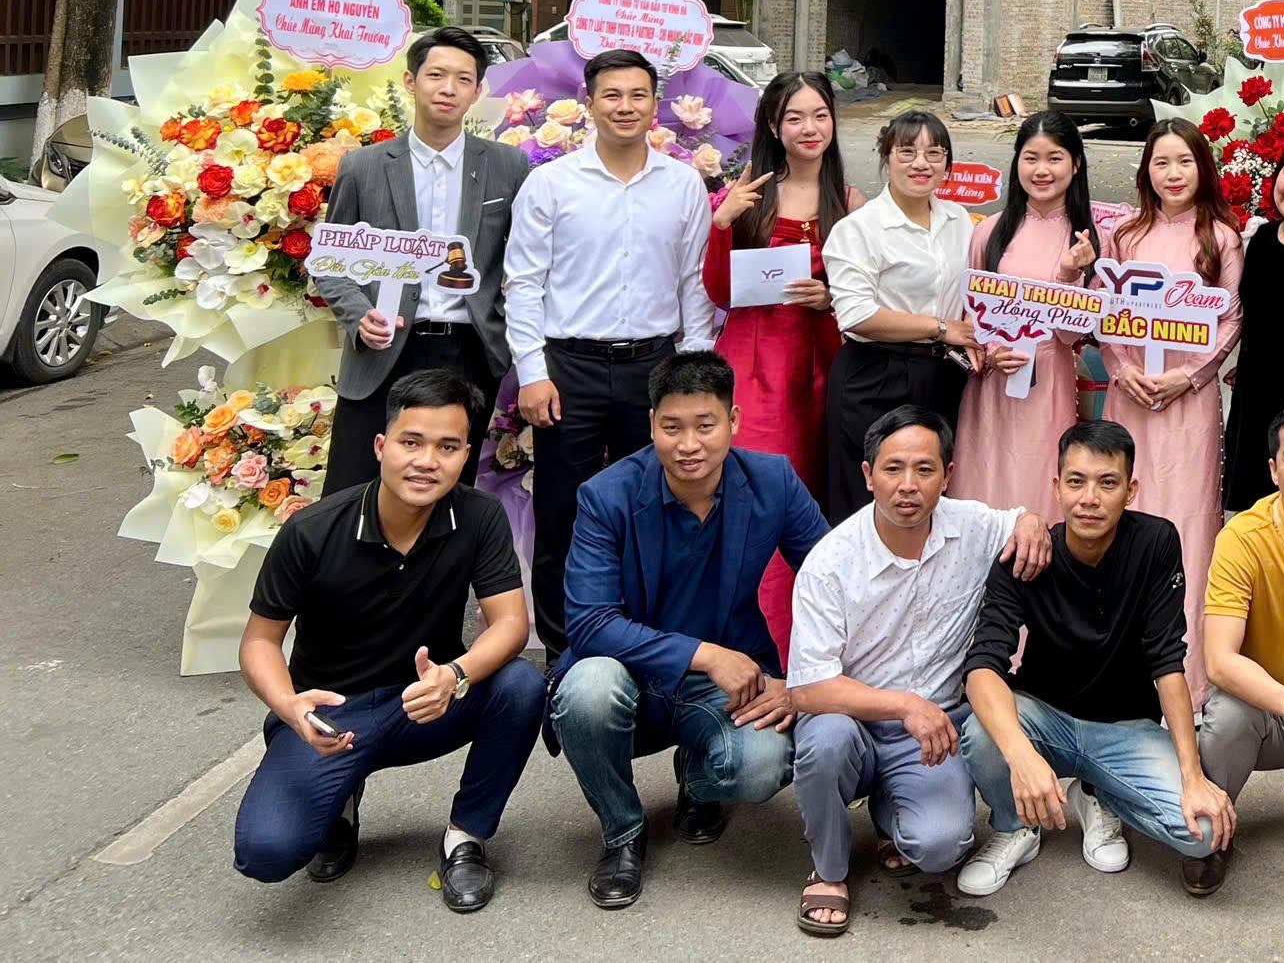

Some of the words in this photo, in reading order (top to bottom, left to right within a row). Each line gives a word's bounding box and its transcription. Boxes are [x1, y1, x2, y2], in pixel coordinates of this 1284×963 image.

[275, 13, 297, 33] Chúc
[328, 1, 340, 17] HỌ
[1254, 14, 1272, 30] CÔNG
[318, 228, 381, 250] PHÁP
[383, 235, 446, 260] LUẬT
[968, 274, 1017, 300] KHAI
[1021, 283, 1102, 314] TRƯƠNG
[1165, 279, 1224, 309] Team
[991, 298, 1042, 325] Hồng
[1047, 306, 1091, 328] Phát
[1102, 308, 1147, 336] BẮC
[1151, 318, 1209, 345] NINH
